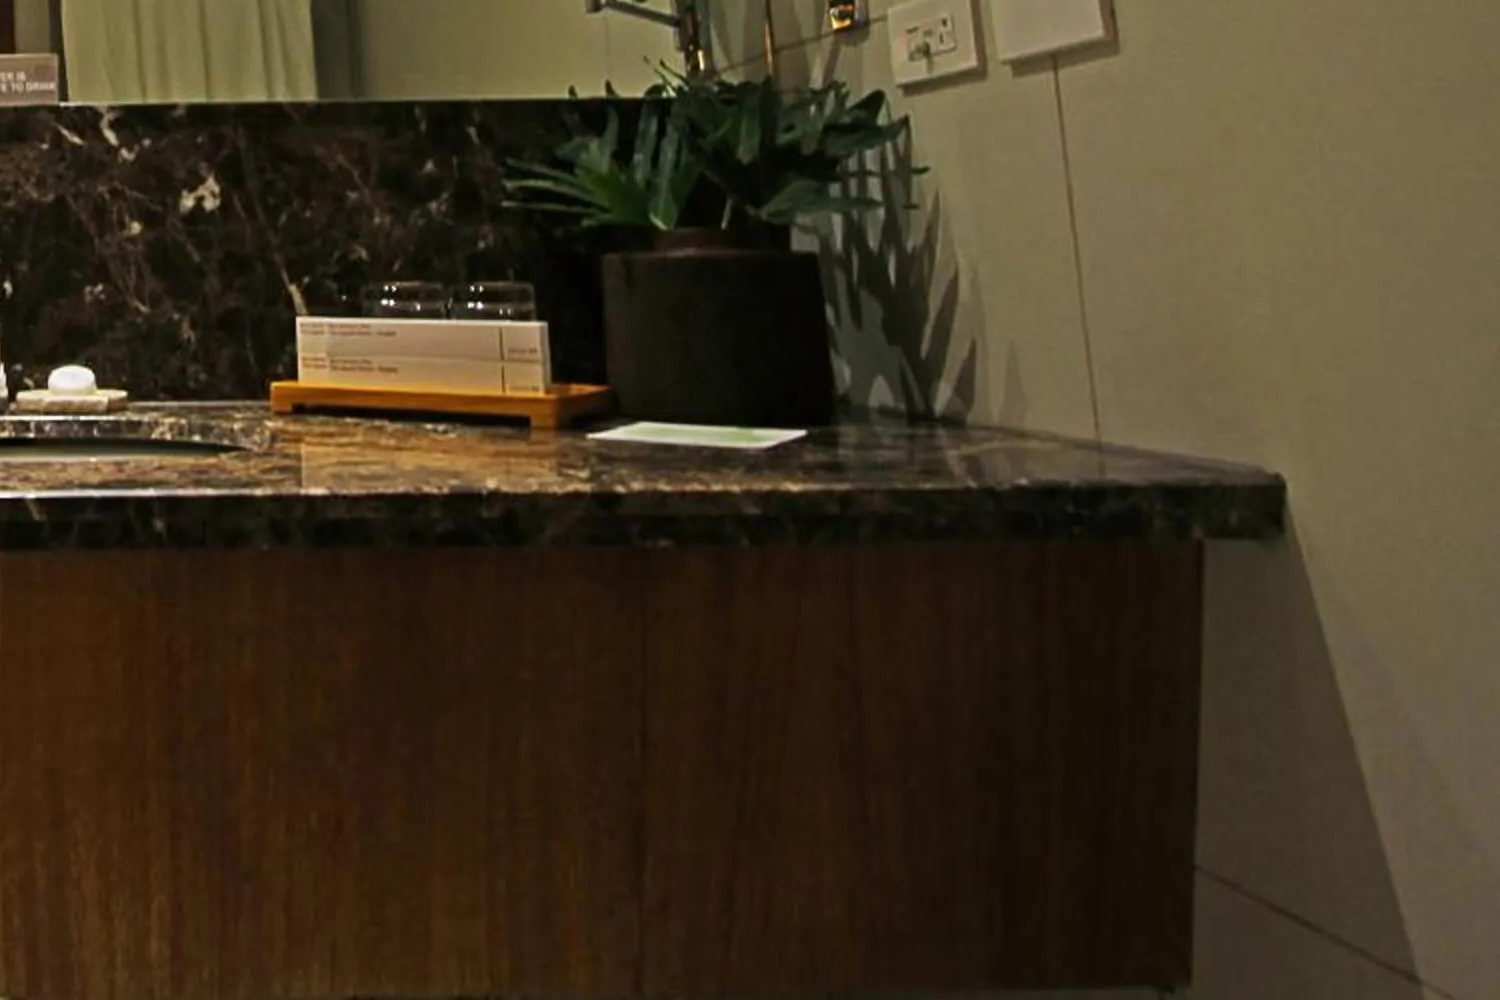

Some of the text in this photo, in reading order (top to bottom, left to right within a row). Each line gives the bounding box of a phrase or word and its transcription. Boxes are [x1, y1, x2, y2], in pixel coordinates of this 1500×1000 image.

[16, 71, 27, 81] IS
[10, 82, 23, 91] TO
[26, 82, 55, 91] DRINK
